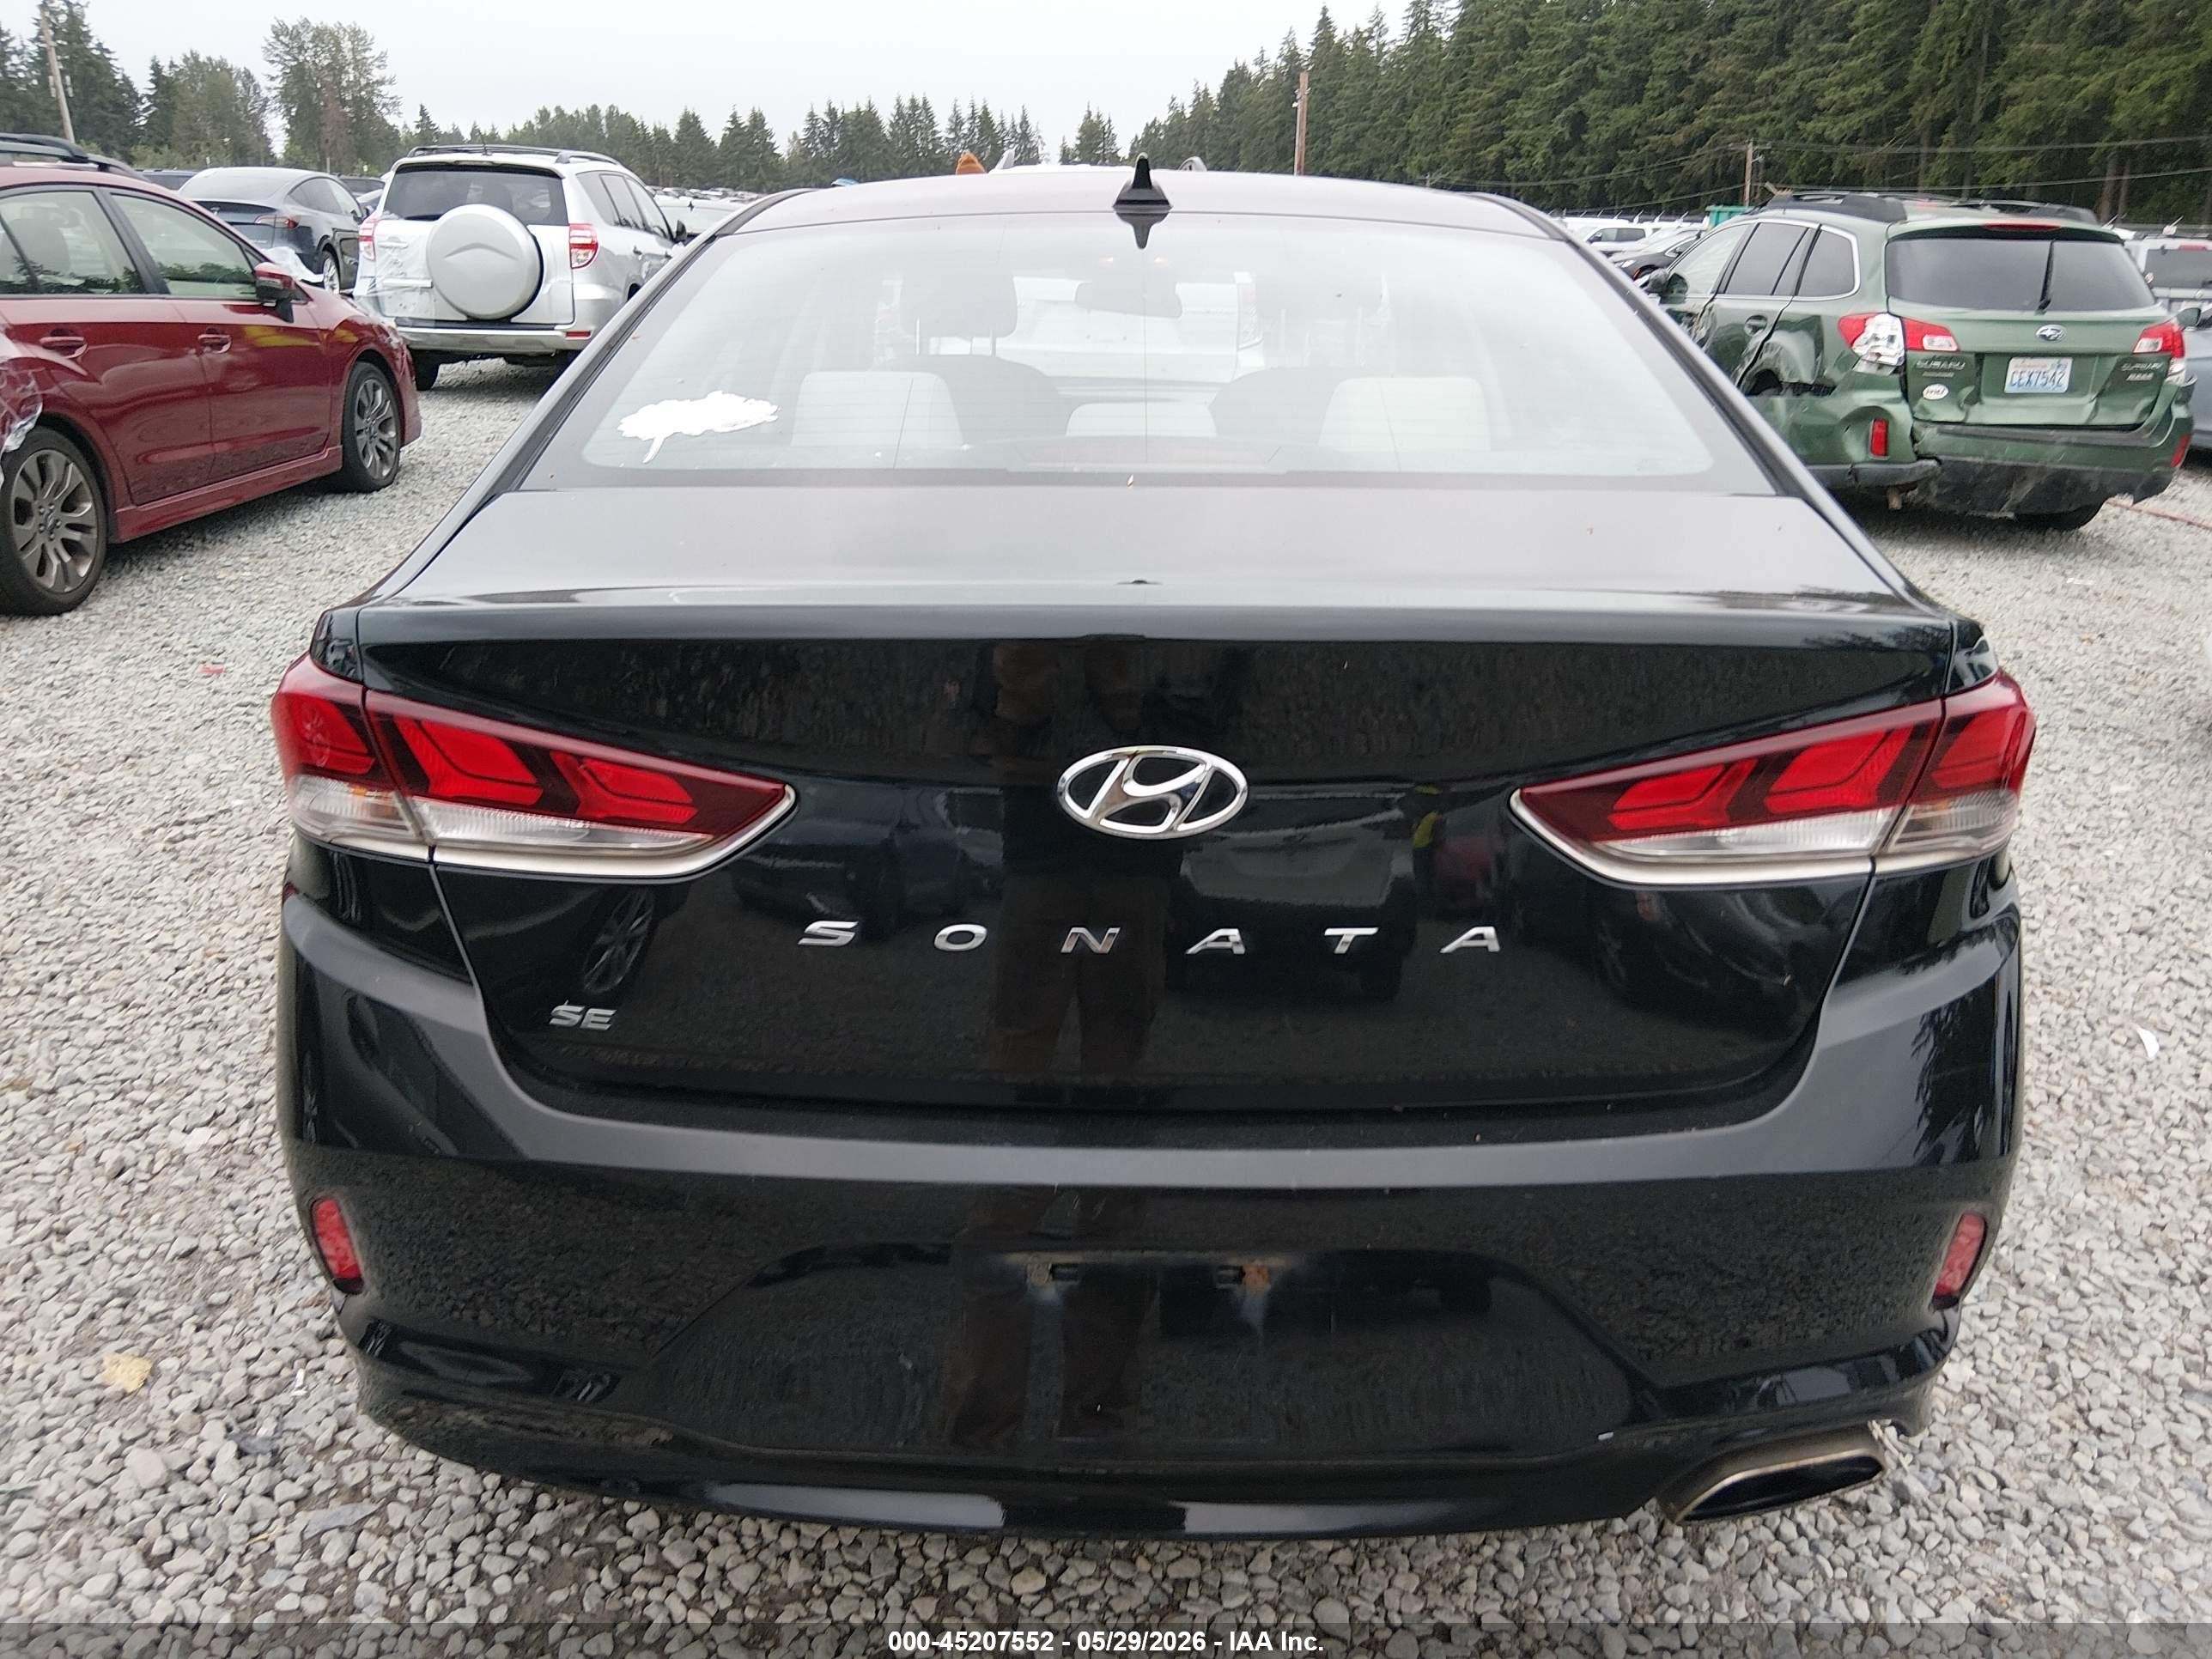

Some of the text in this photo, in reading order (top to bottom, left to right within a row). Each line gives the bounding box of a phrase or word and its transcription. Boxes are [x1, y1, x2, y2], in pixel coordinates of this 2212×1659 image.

[1916, 361, 1966, 370] SUBARU
[2009, 370, 2065, 387] CEX7542
[798, 921, 1501, 955] SONATA
[549, 1005, 617, 1030] SE
